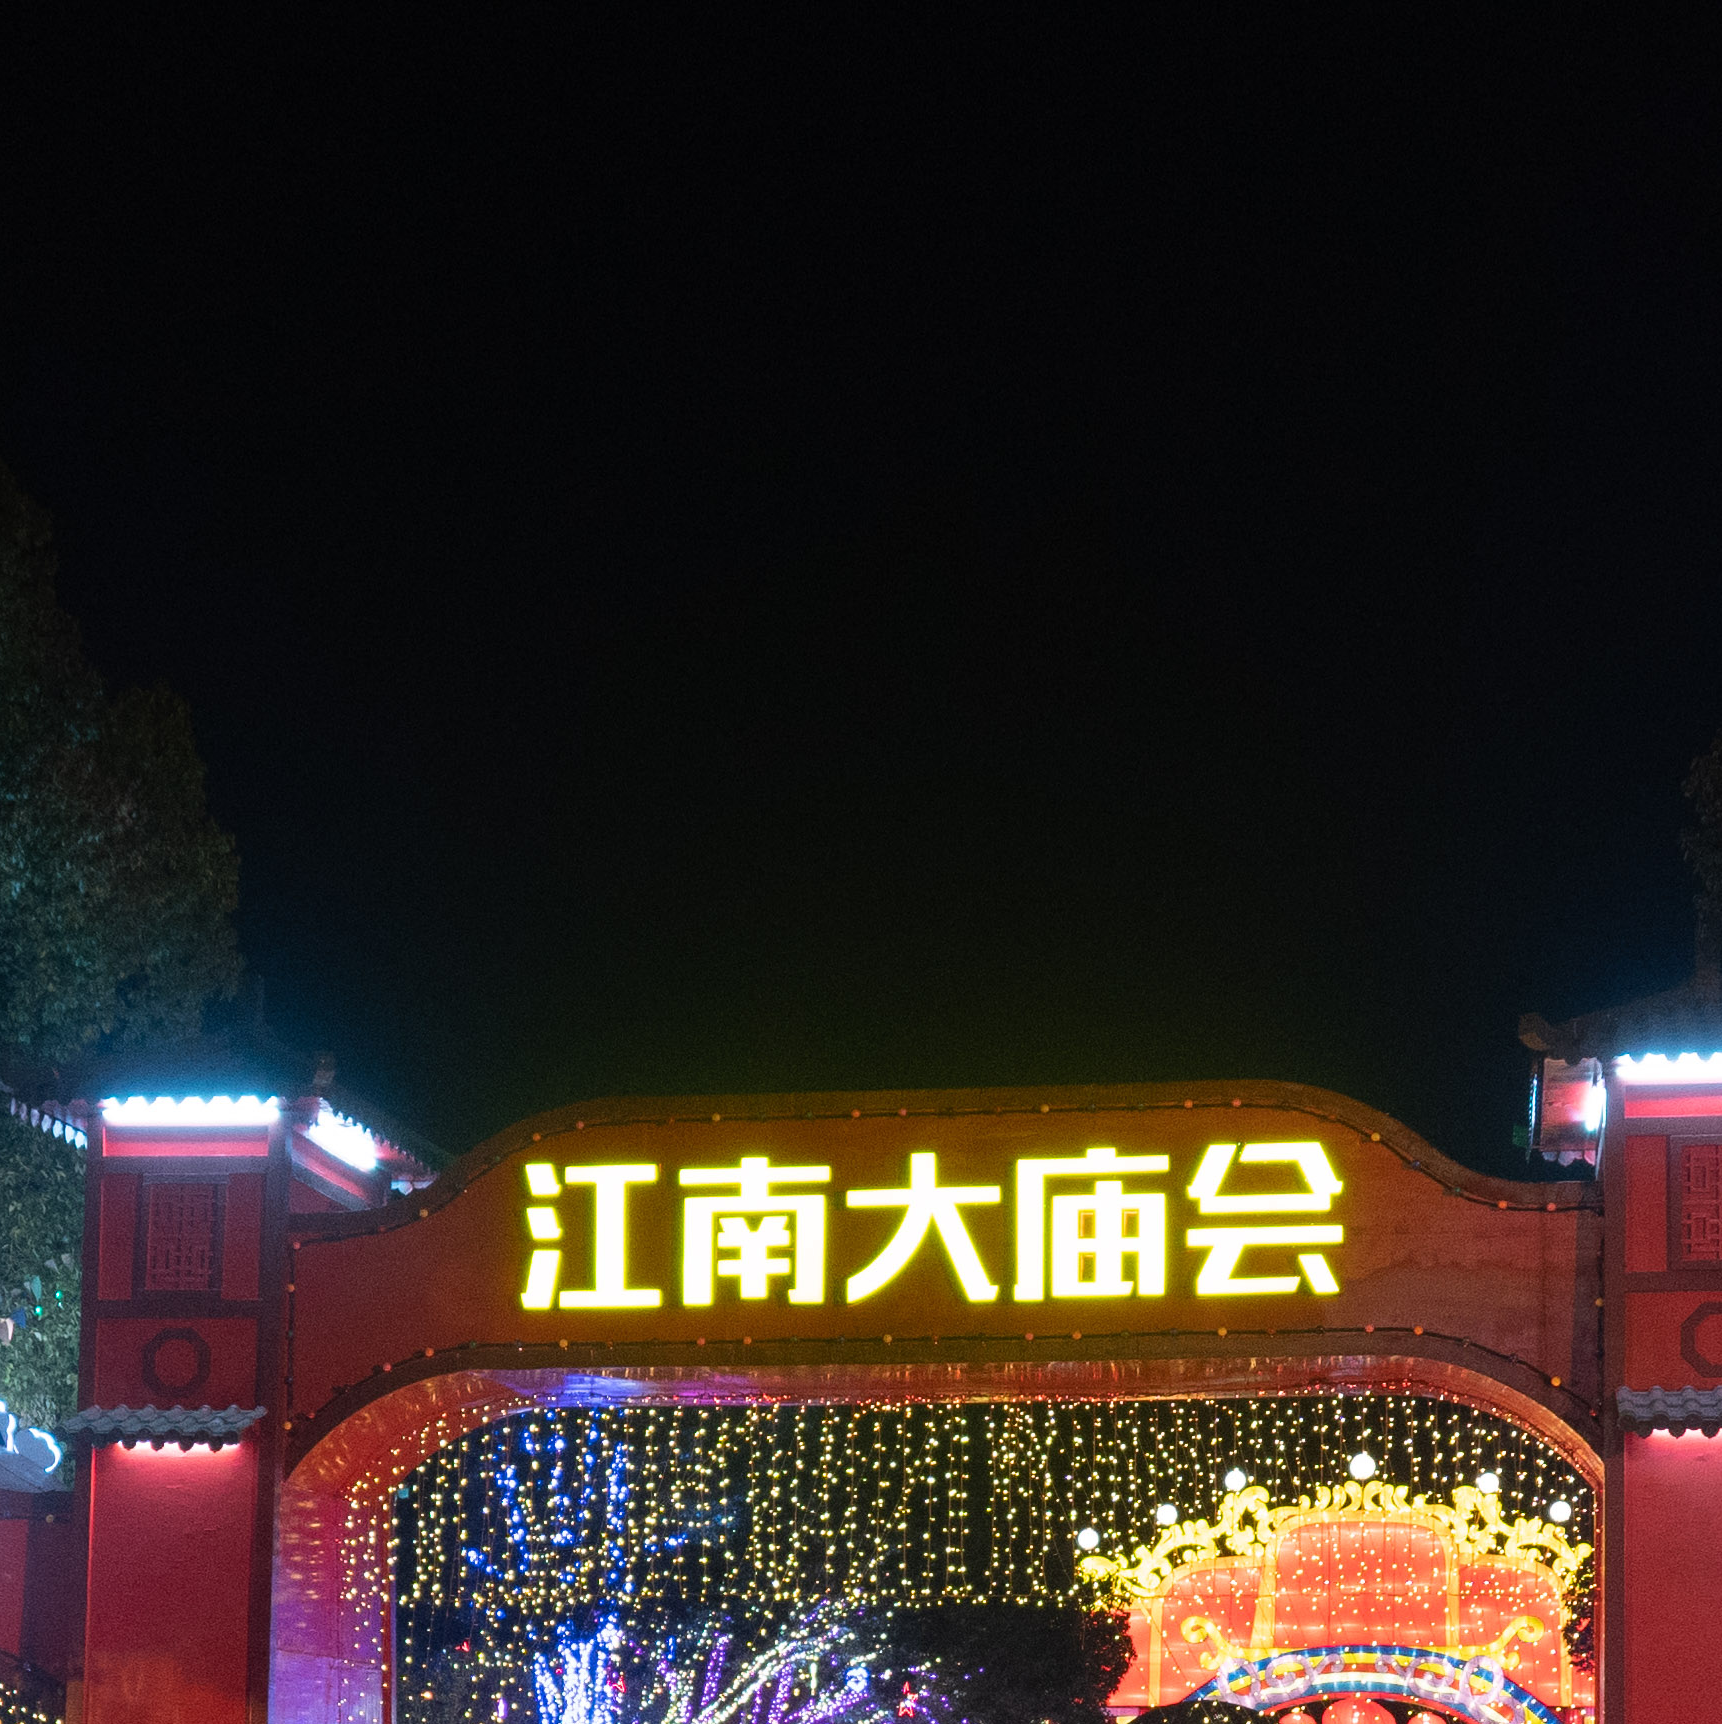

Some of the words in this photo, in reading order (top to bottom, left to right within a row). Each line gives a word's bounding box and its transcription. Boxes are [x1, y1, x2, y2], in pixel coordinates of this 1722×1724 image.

[519, 1140, 1345, 1310] 江南大庙会
